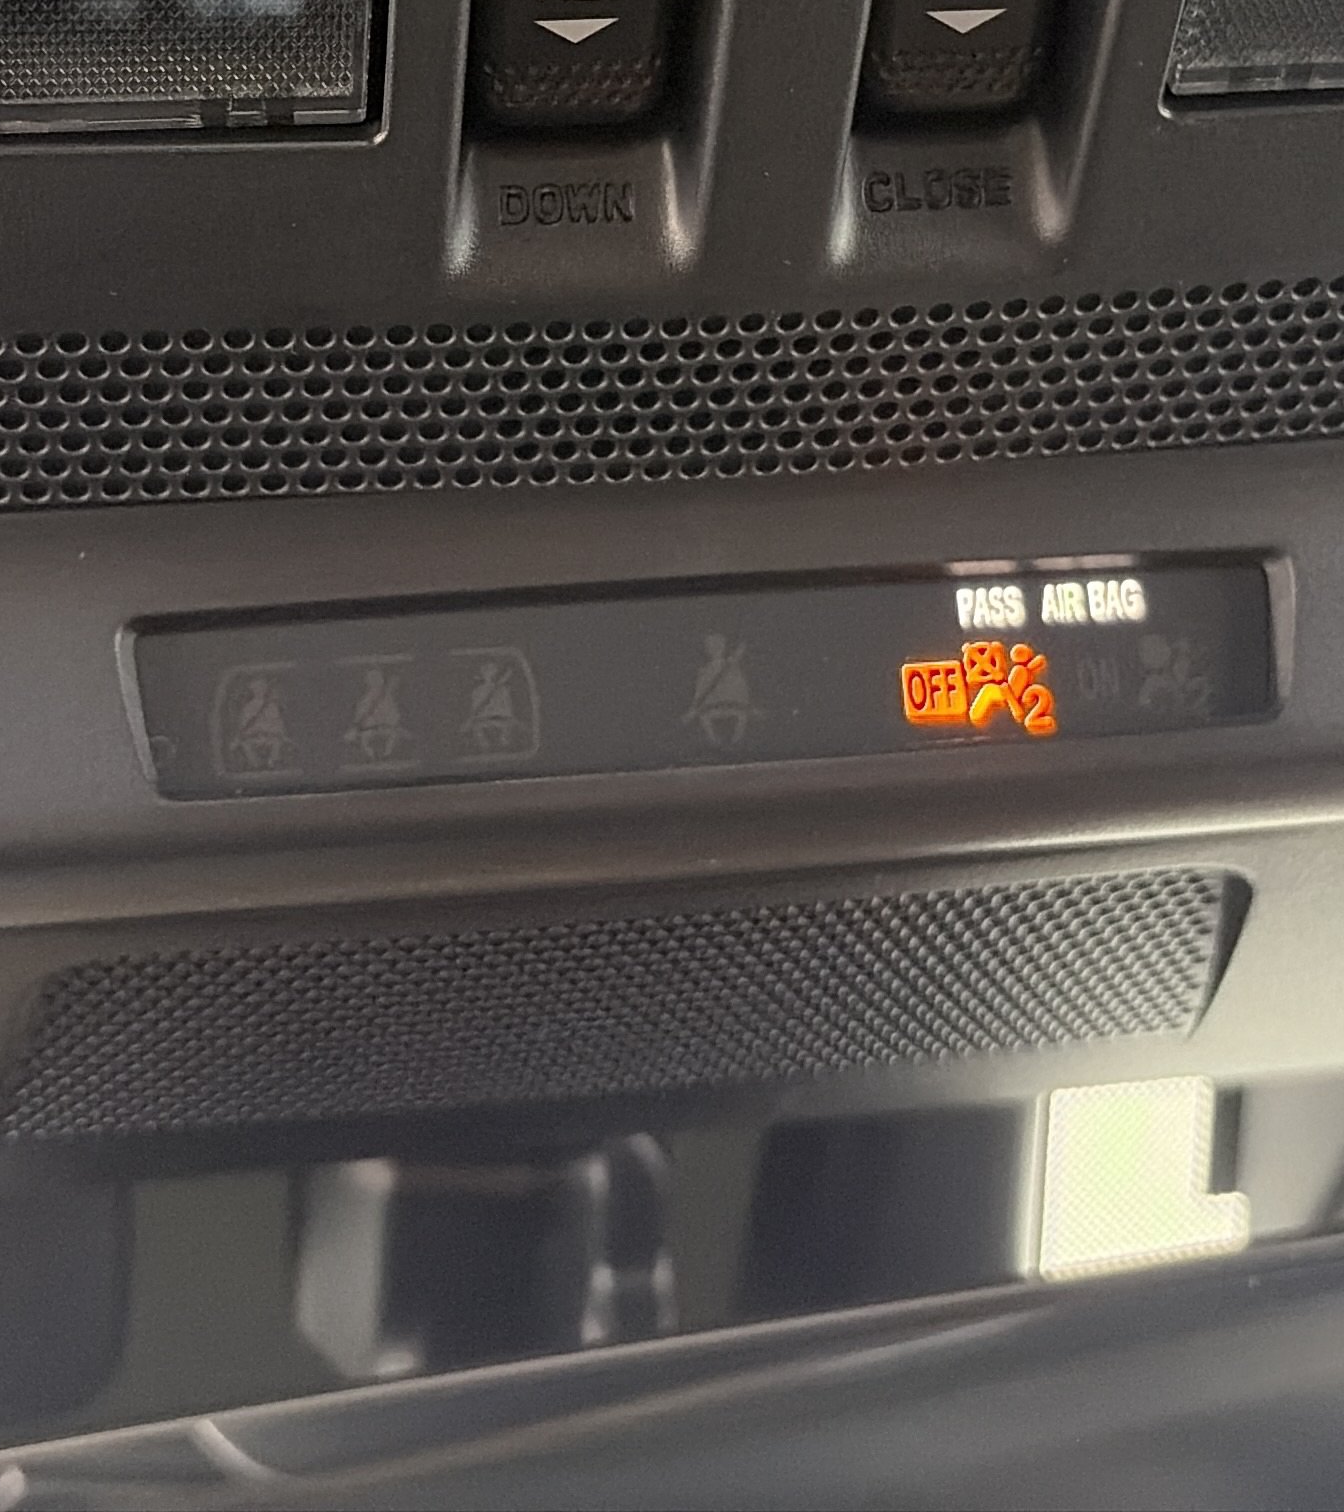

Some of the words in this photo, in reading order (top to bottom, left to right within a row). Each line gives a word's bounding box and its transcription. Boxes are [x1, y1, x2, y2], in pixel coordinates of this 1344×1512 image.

[498, 181, 636, 226] DOWN
[861, 167, 1014, 213] CLOSE
[956, 587, 1025, 629] PASS
[908, 669, 958, 711] OFF
